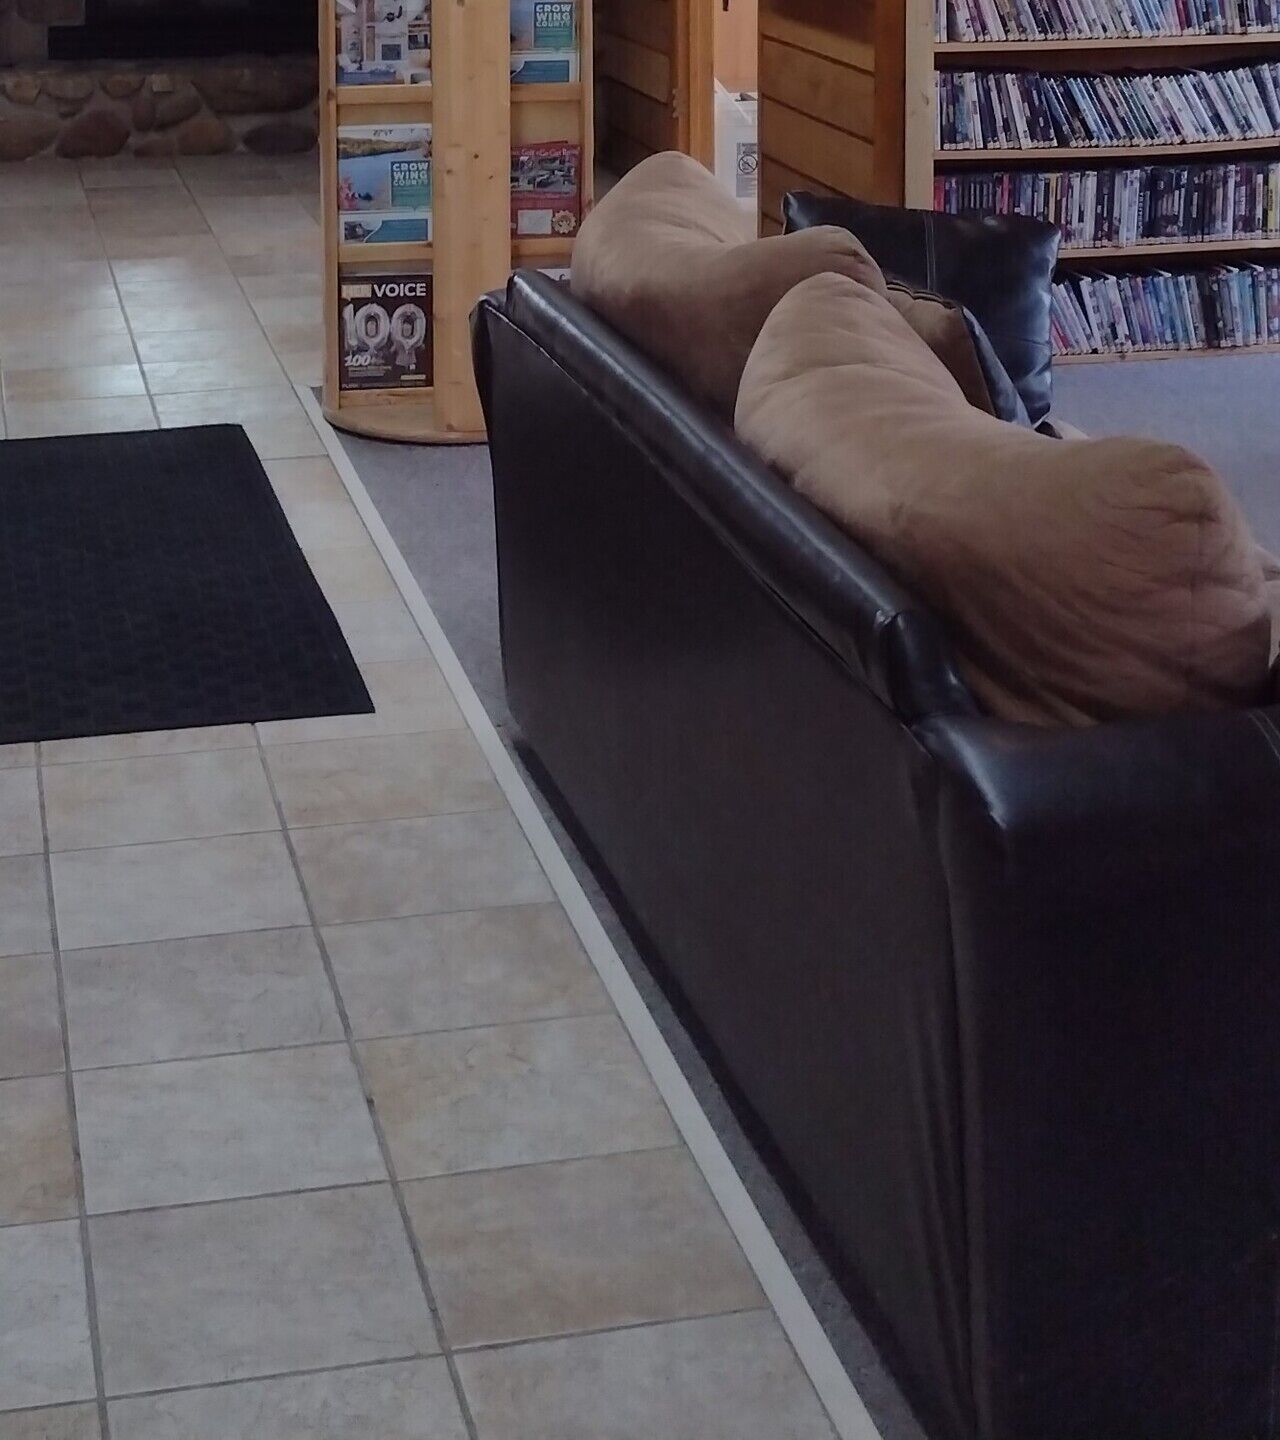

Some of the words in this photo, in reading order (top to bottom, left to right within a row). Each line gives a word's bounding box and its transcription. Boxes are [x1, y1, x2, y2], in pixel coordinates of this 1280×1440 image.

[536, 4, 572, 12] CROW
[536, 12, 571, 21] WING
[392, 162, 429, 171] CROW
[393, 171, 428, 180] WING
[373, 283, 427, 297] VOICE
[344, 354, 371, 367] 100
